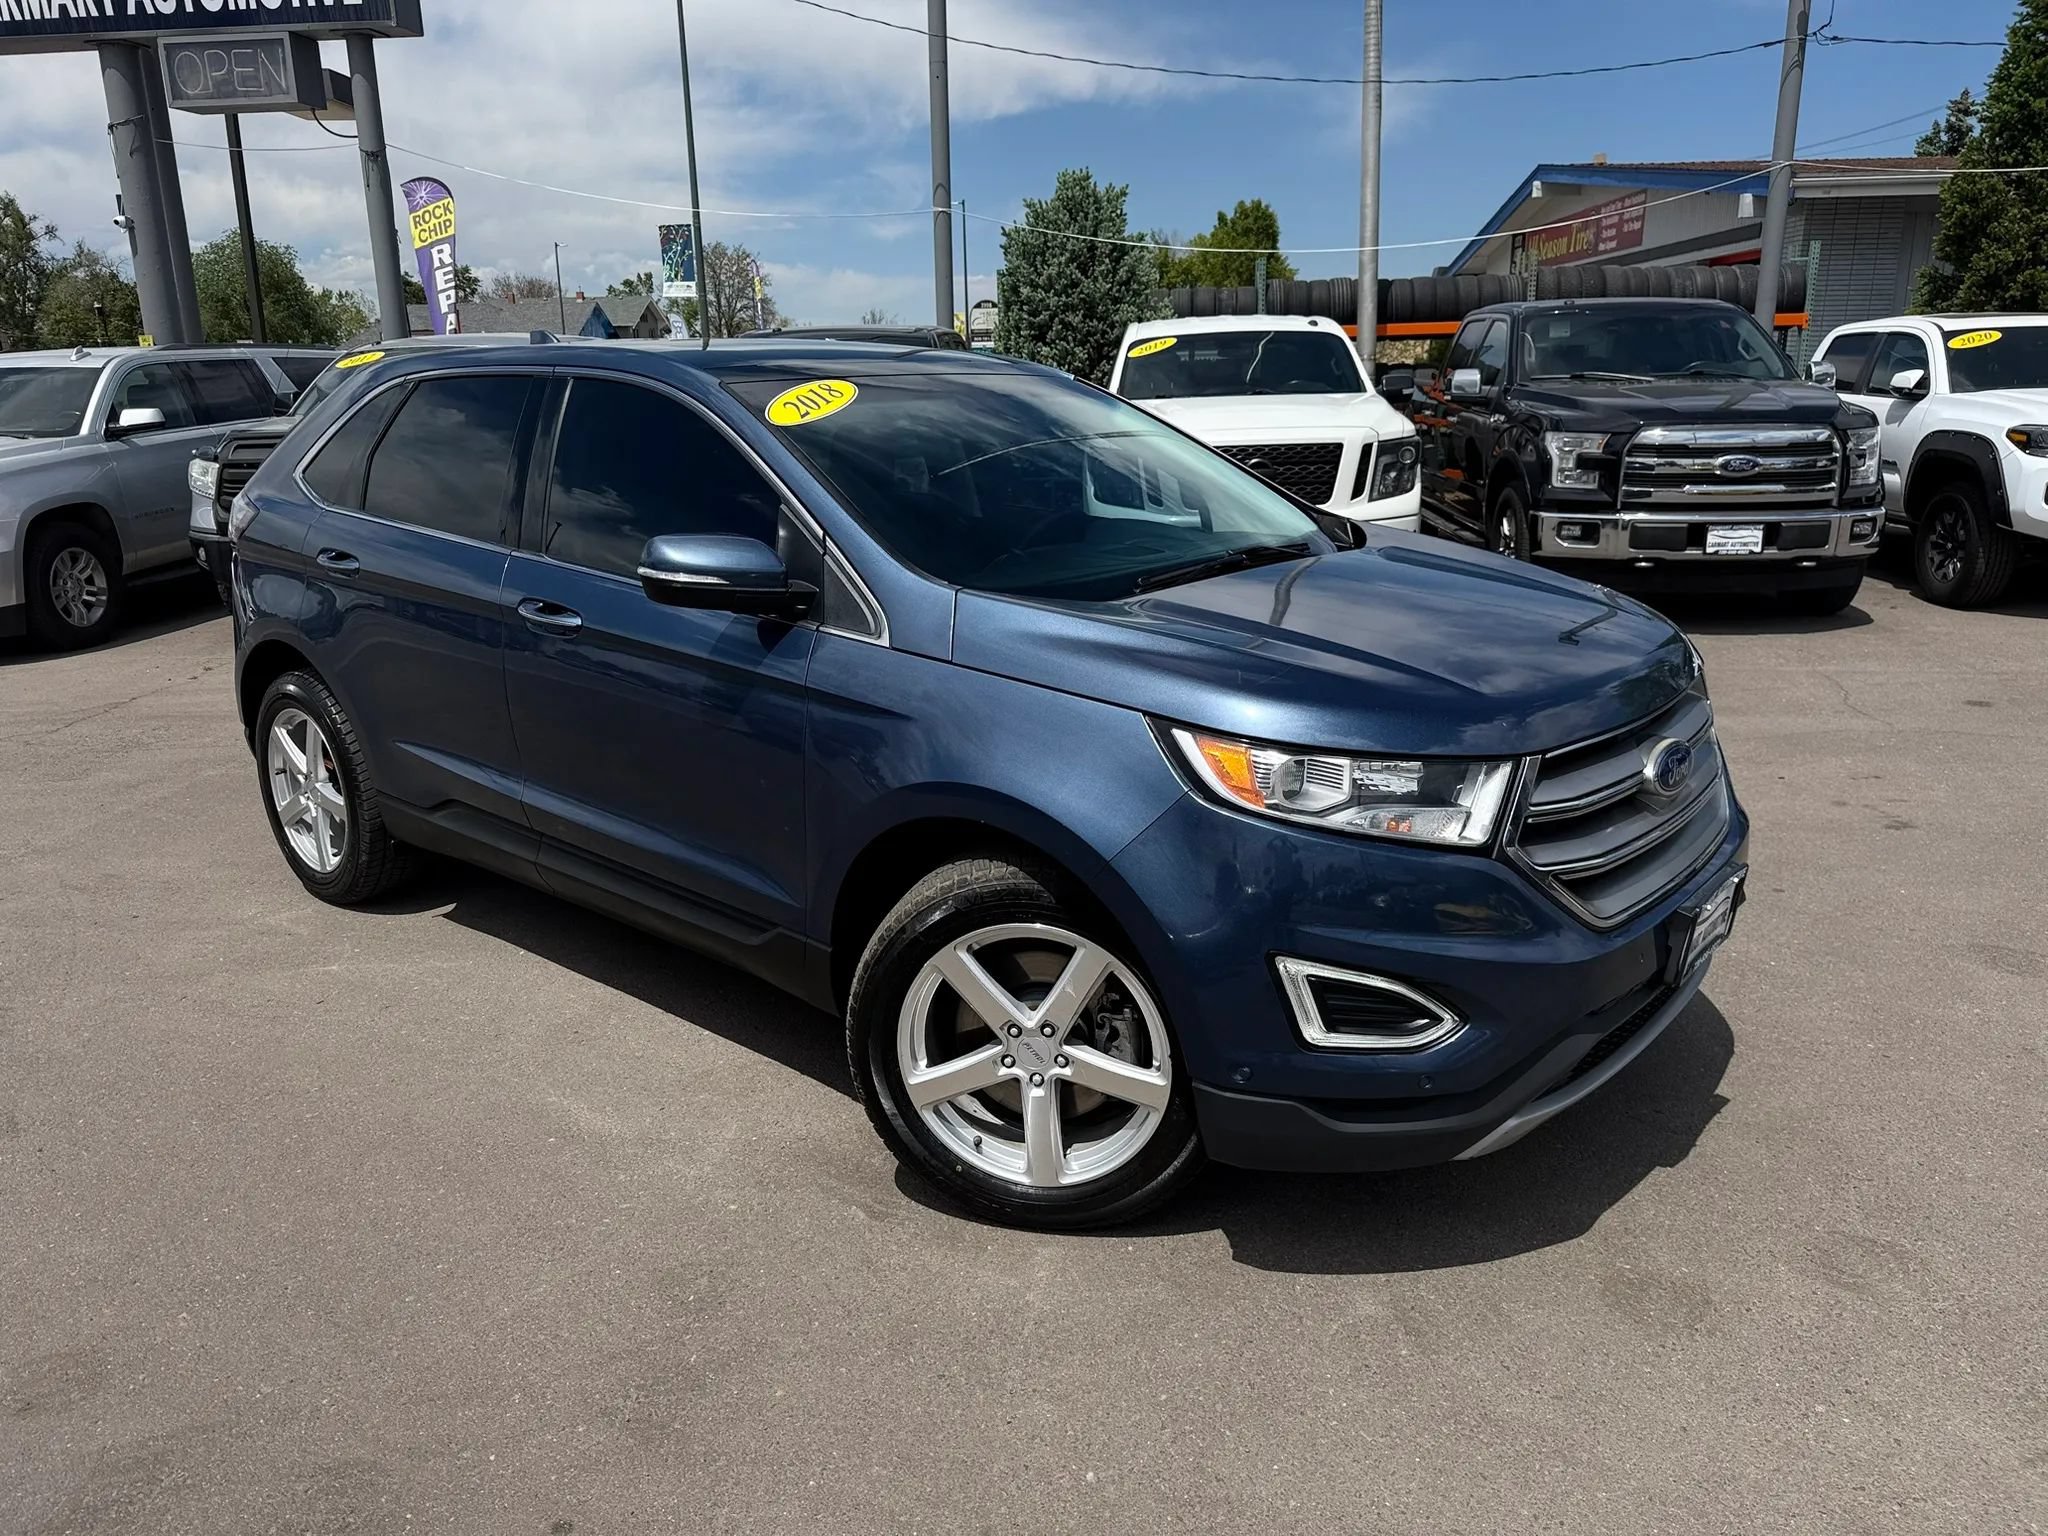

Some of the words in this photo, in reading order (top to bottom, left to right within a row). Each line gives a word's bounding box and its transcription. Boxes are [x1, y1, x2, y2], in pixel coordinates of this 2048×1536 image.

[174, 48, 287, 95] OPEN
[412, 201, 454, 230] ROCK
[418, 218, 453, 244] CHIP
[1137, 340, 1167, 355] 2019
[1960, 331, 1993, 347] 2020
[783, 383, 844, 419] 2018
[1727, 459, 1753, 471] Ford
[1668, 752, 1689, 786] Ford
